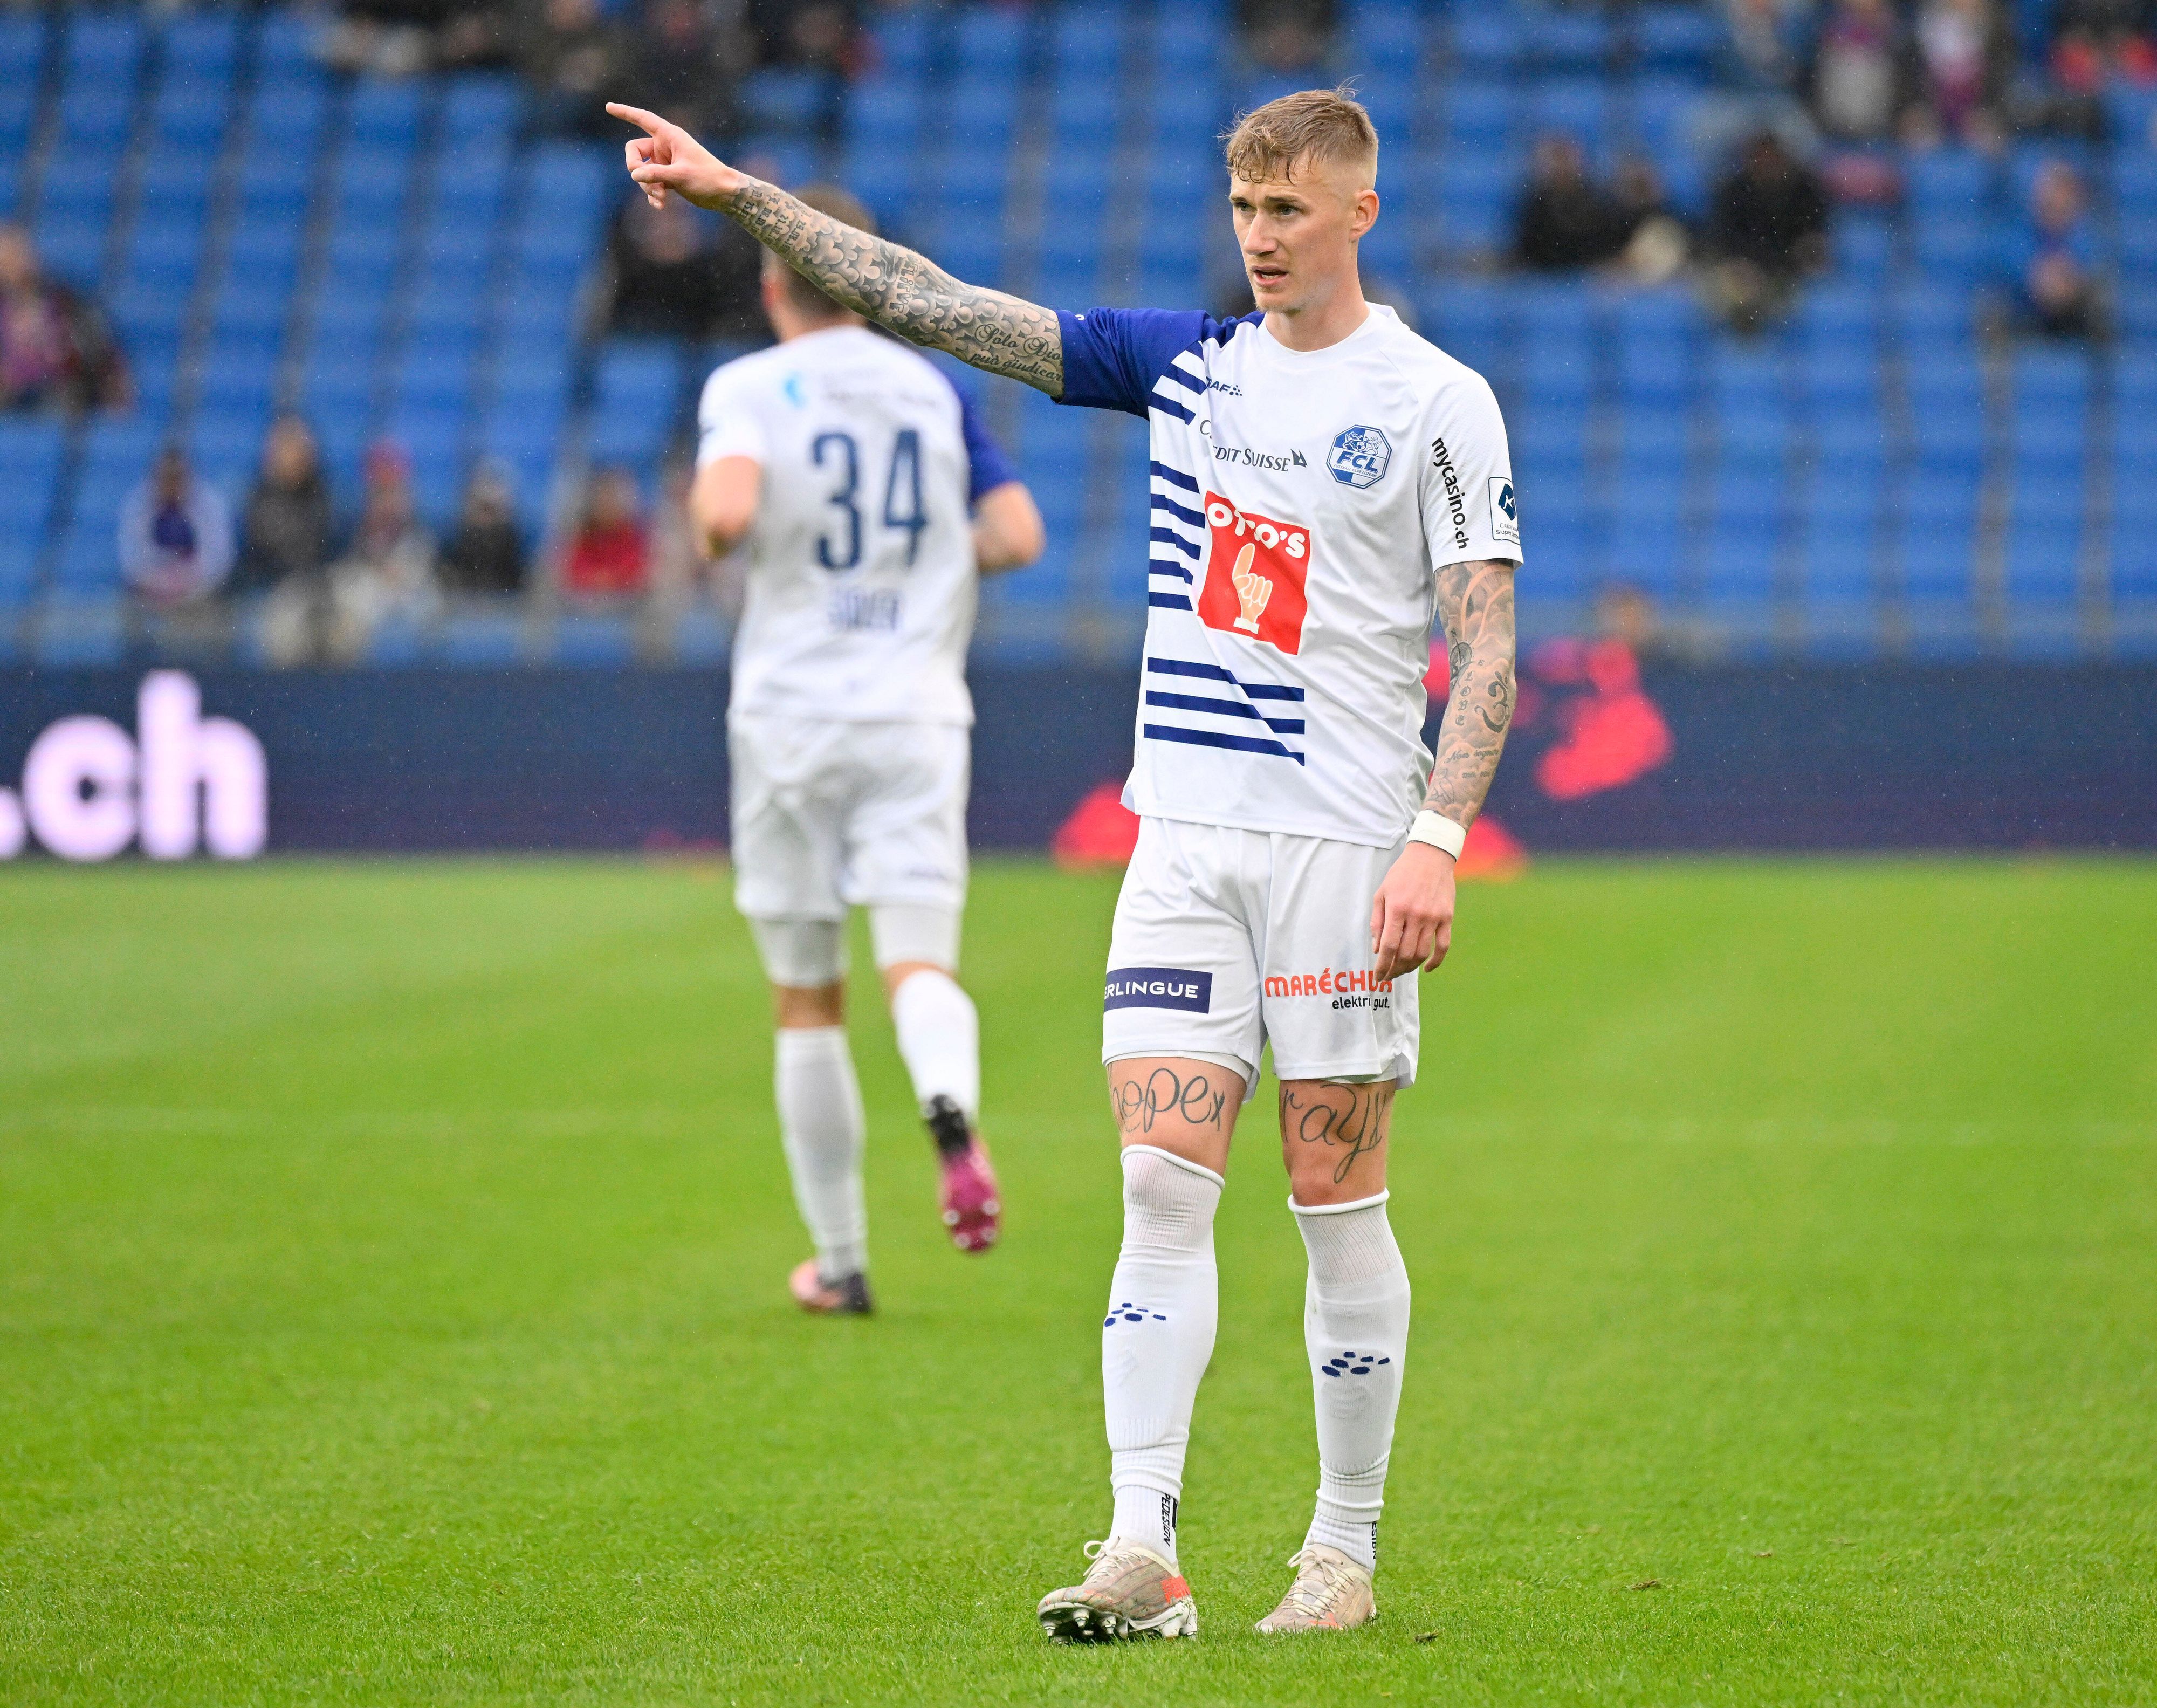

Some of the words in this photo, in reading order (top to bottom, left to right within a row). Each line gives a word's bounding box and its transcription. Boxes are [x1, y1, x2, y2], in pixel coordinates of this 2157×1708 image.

[1242, 448, 1290, 472] SUISSE
[1336, 450, 1379, 474] FCL
[810, 428, 929, 573] 34
[1431, 437, 1469, 550] mycasino.ch
[1373, 997, 1390, 1011] gut.
